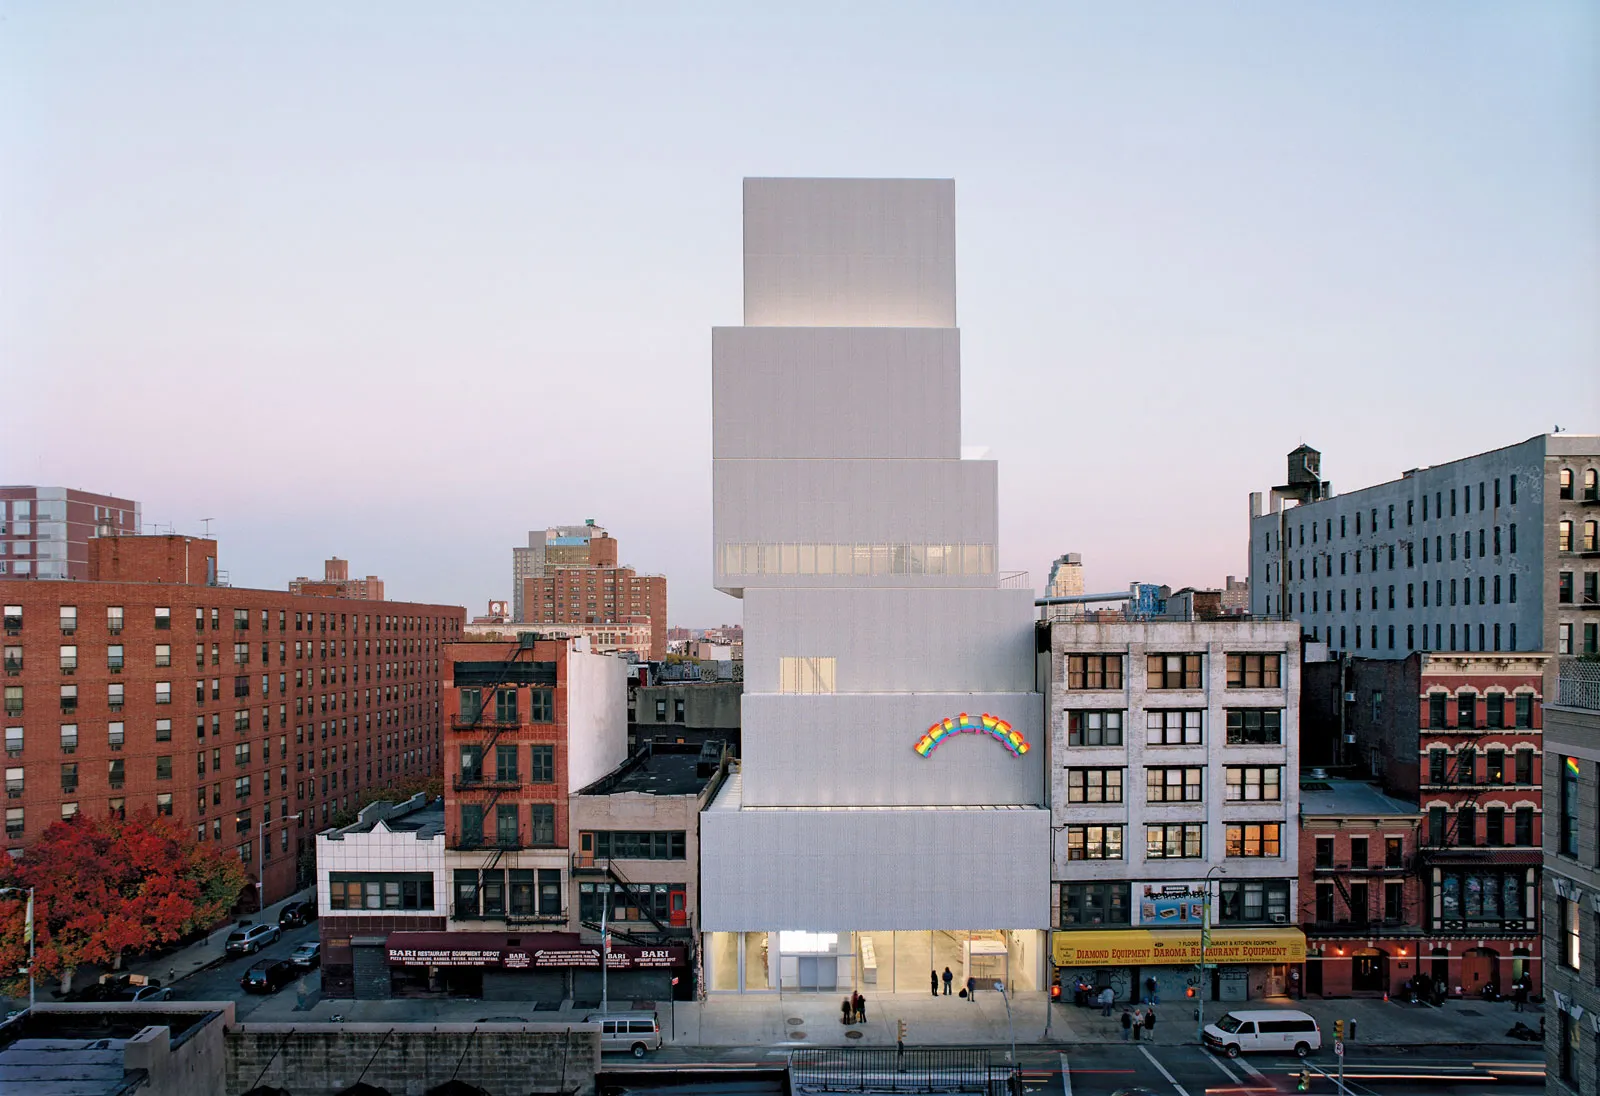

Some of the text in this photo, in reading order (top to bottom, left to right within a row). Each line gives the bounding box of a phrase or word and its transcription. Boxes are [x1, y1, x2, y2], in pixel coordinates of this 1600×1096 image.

[389, 949, 417, 957] BARI
[641, 950, 669, 958] BARI
[1190, 947, 1240, 957] RETAURANT
